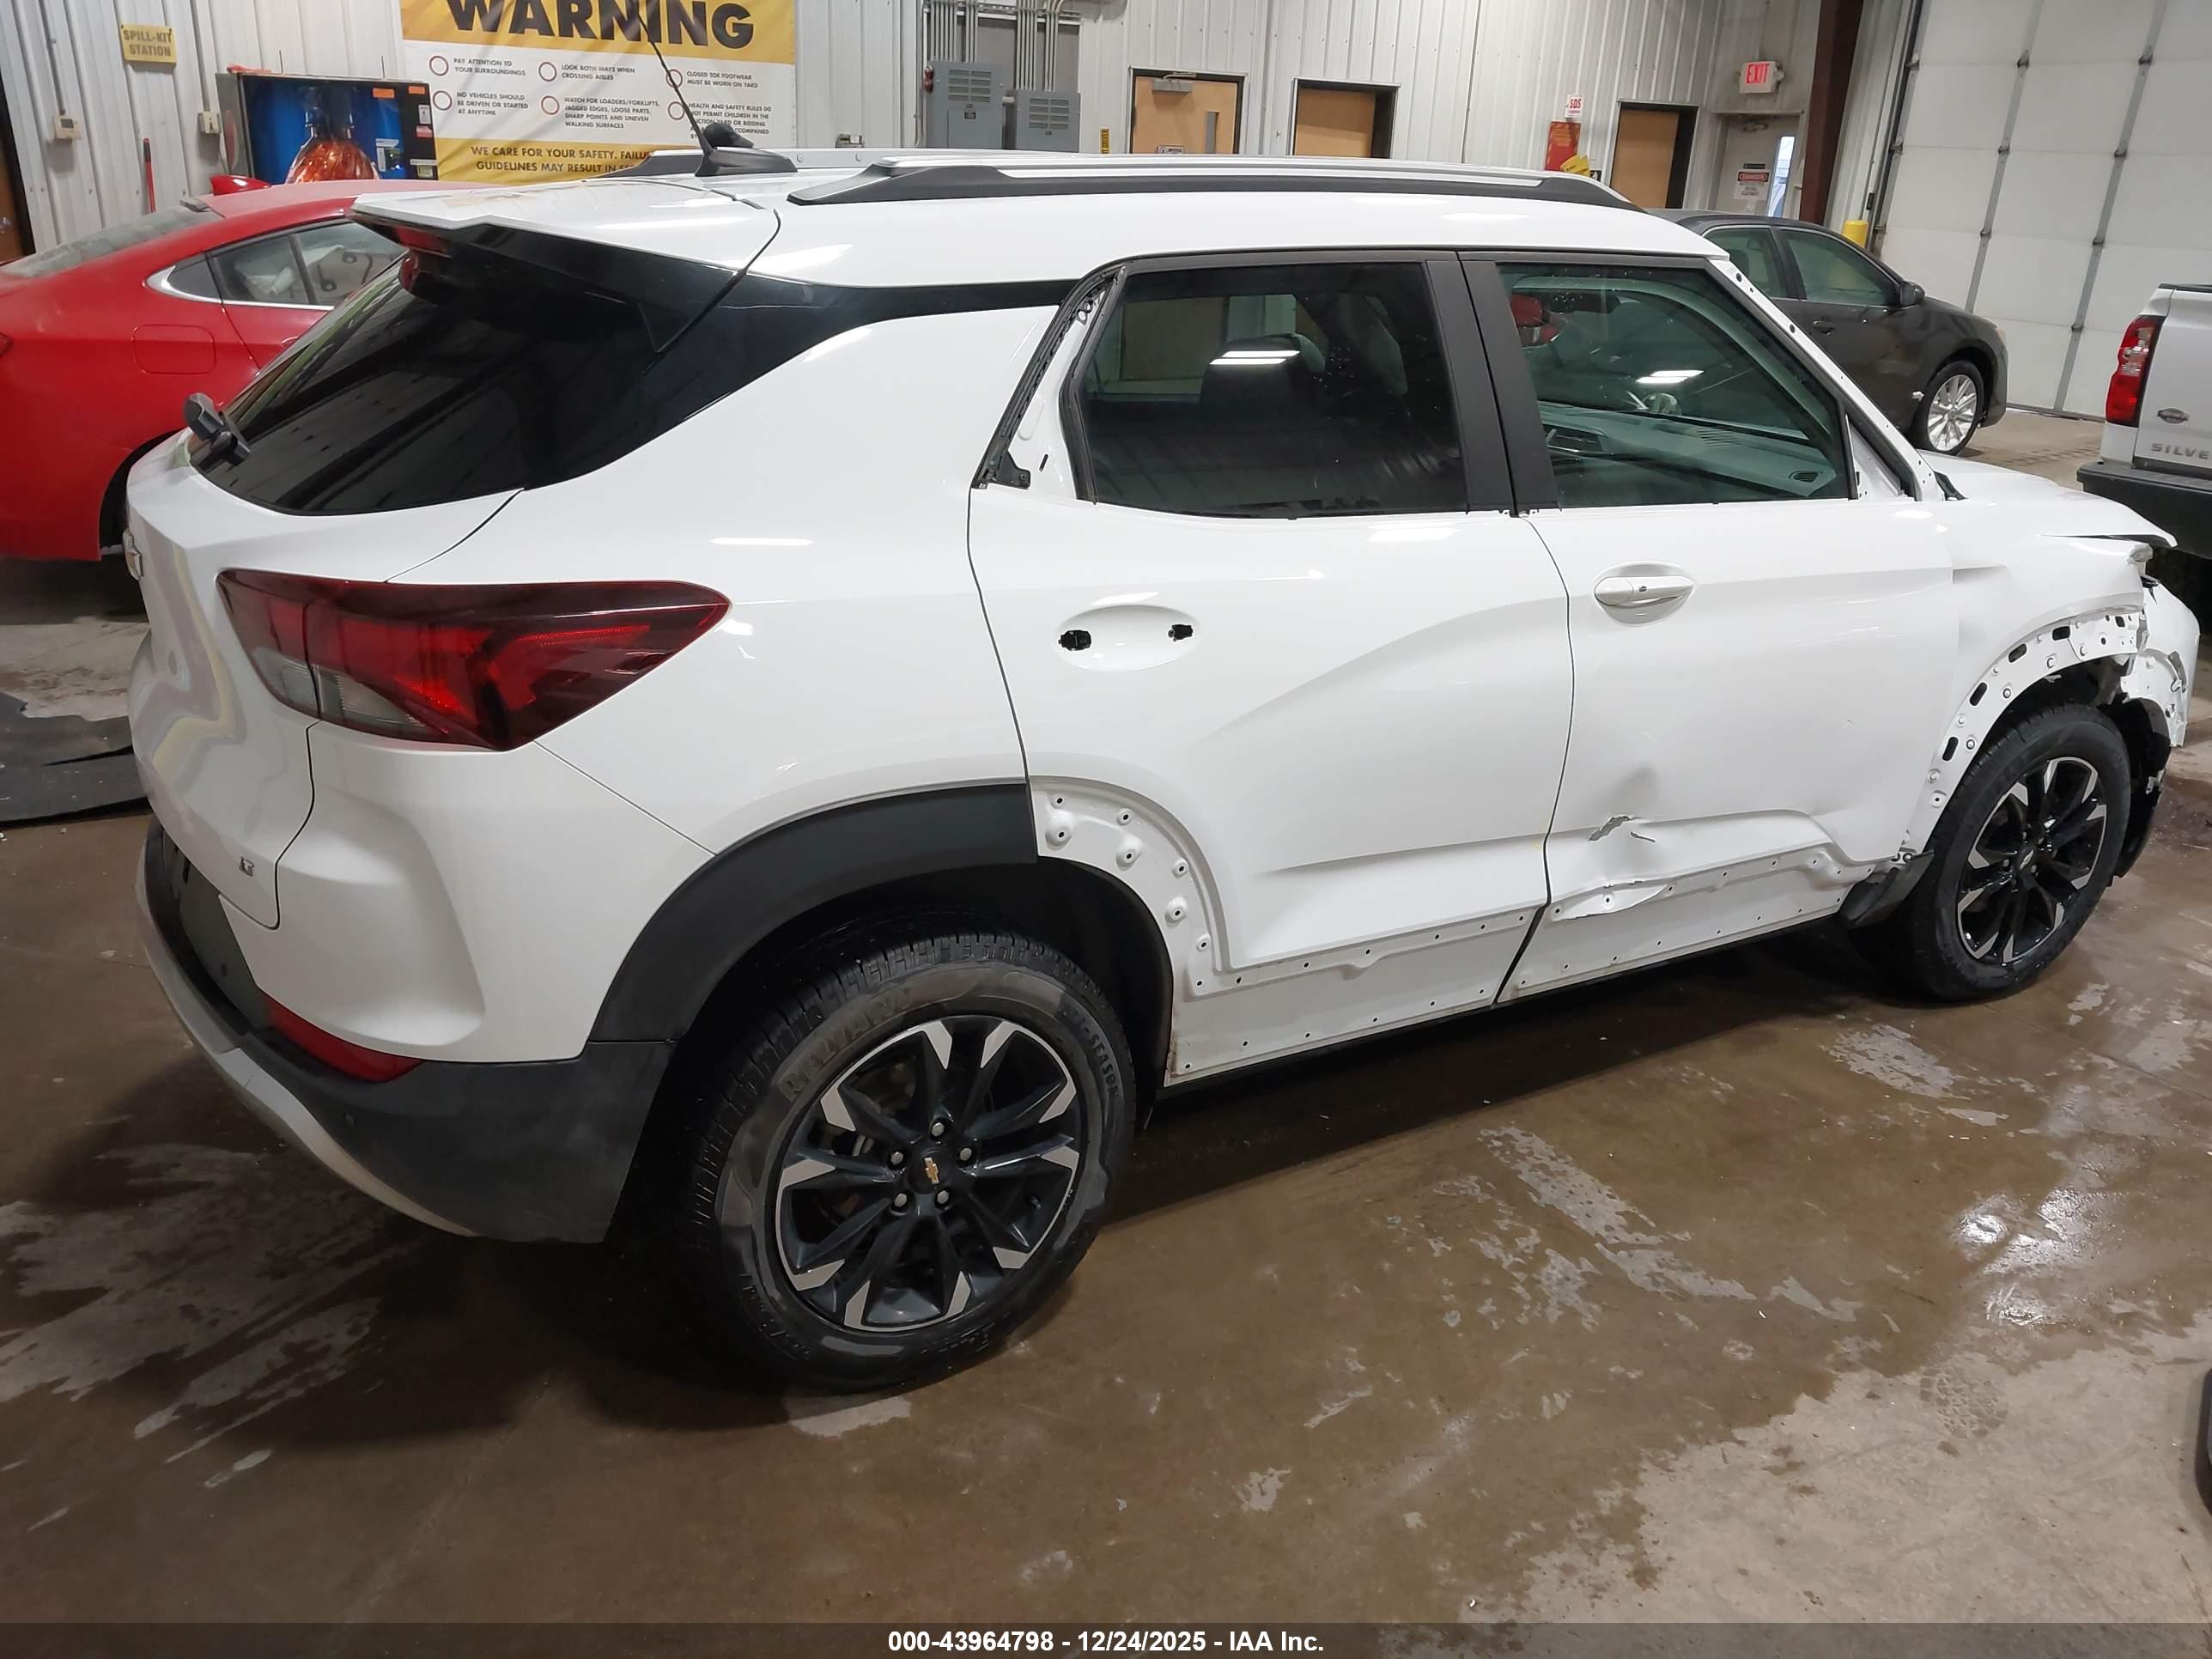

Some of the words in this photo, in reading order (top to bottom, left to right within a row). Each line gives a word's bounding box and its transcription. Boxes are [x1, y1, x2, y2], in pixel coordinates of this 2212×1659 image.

[447, 0, 754, 49] WARNING
[124, 29, 172, 42] SPILL-KIT
[129, 45, 171, 57] STATION
[474, 67, 526, 76] SURROUNDINGS
[1746, 64, 1770, 84] EXIT
[471, 146, 489, 155] WE
[492, 147, 519, 156] CARE
[522, 148, 543, 157] FOR
[546, 149, 575, 158] YOUR
[579, 149, 618, 160] SAFETY.
[476, 161, 538, 172] GUIDELINES
[541, 163, 563, 172] MAY
[568, 163, 602, 173] RESULT
[605, 165, 617, 173] IN
[2149, 443, 2210, 460] SILVE
